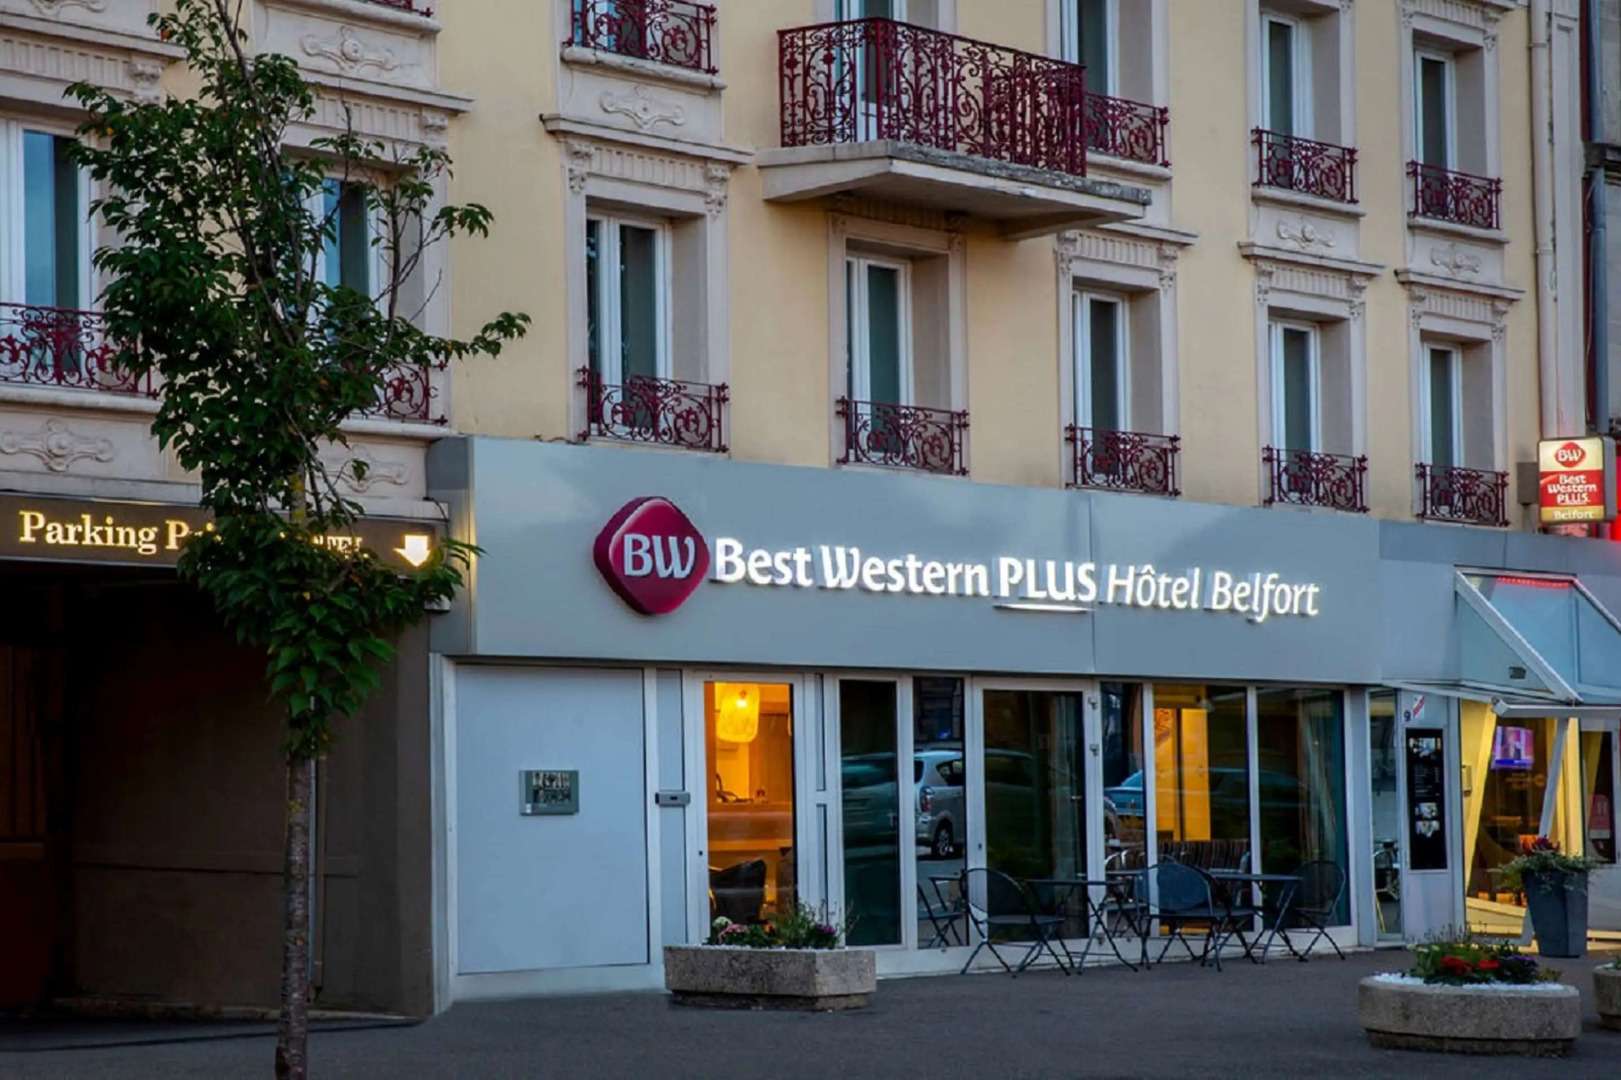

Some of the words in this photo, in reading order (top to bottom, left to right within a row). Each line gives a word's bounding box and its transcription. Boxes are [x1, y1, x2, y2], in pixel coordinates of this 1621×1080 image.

[1556, 448, 1582, 462] BW
[1559, 474, 1586, 484] Best
[1547, 484, 1597, 493] Western
[1557, 493, 1589, 503] PLUS
[1553, 510, 1594, 520] Belfort
[19, 510, 159, 555] Parking
[623, 532, 697, 580] BW
[715, 537, 814, 588] Best
[819, 544, 990, 598] Western
[997, 556, 1097, 603] PLUS
[1106, 563, 1201, 610] Hôtel
[1210, 570, 1320, 623] Belfort
